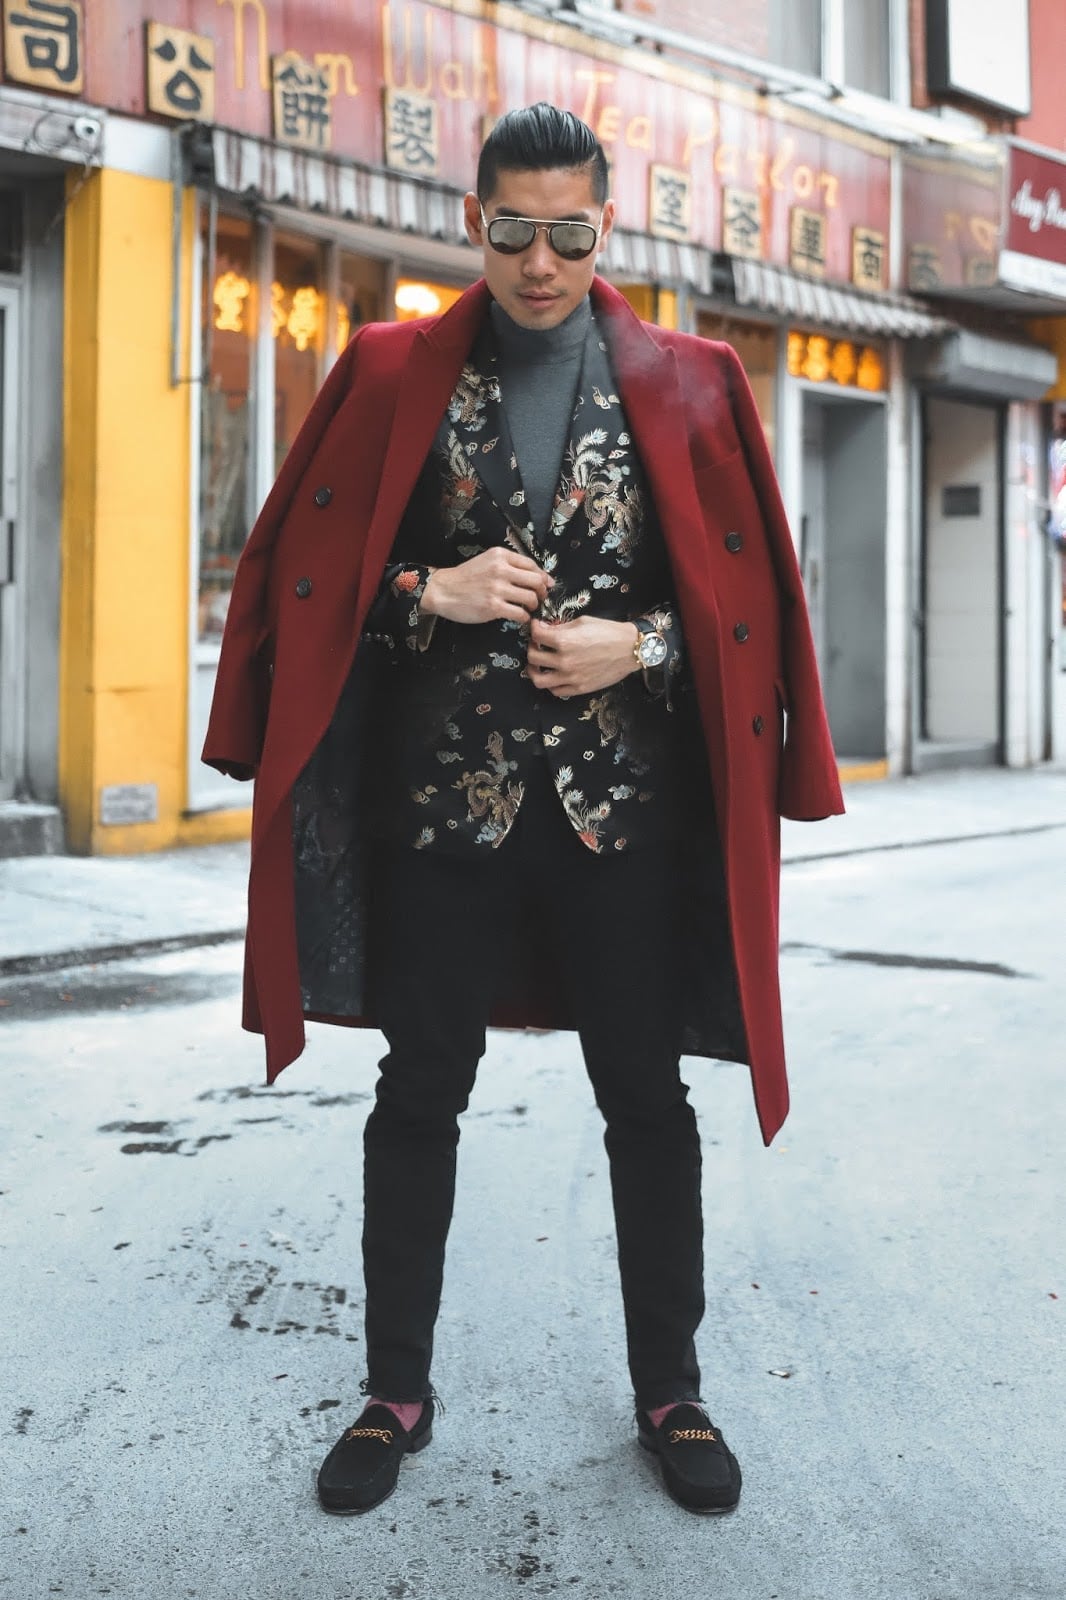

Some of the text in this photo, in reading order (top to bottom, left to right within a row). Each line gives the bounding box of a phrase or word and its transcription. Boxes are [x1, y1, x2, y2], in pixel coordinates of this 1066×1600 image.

[9, 0, 79, 82] 司
[153, 39, 212, 111] 公
[574, 68, 652, 152] Tea
